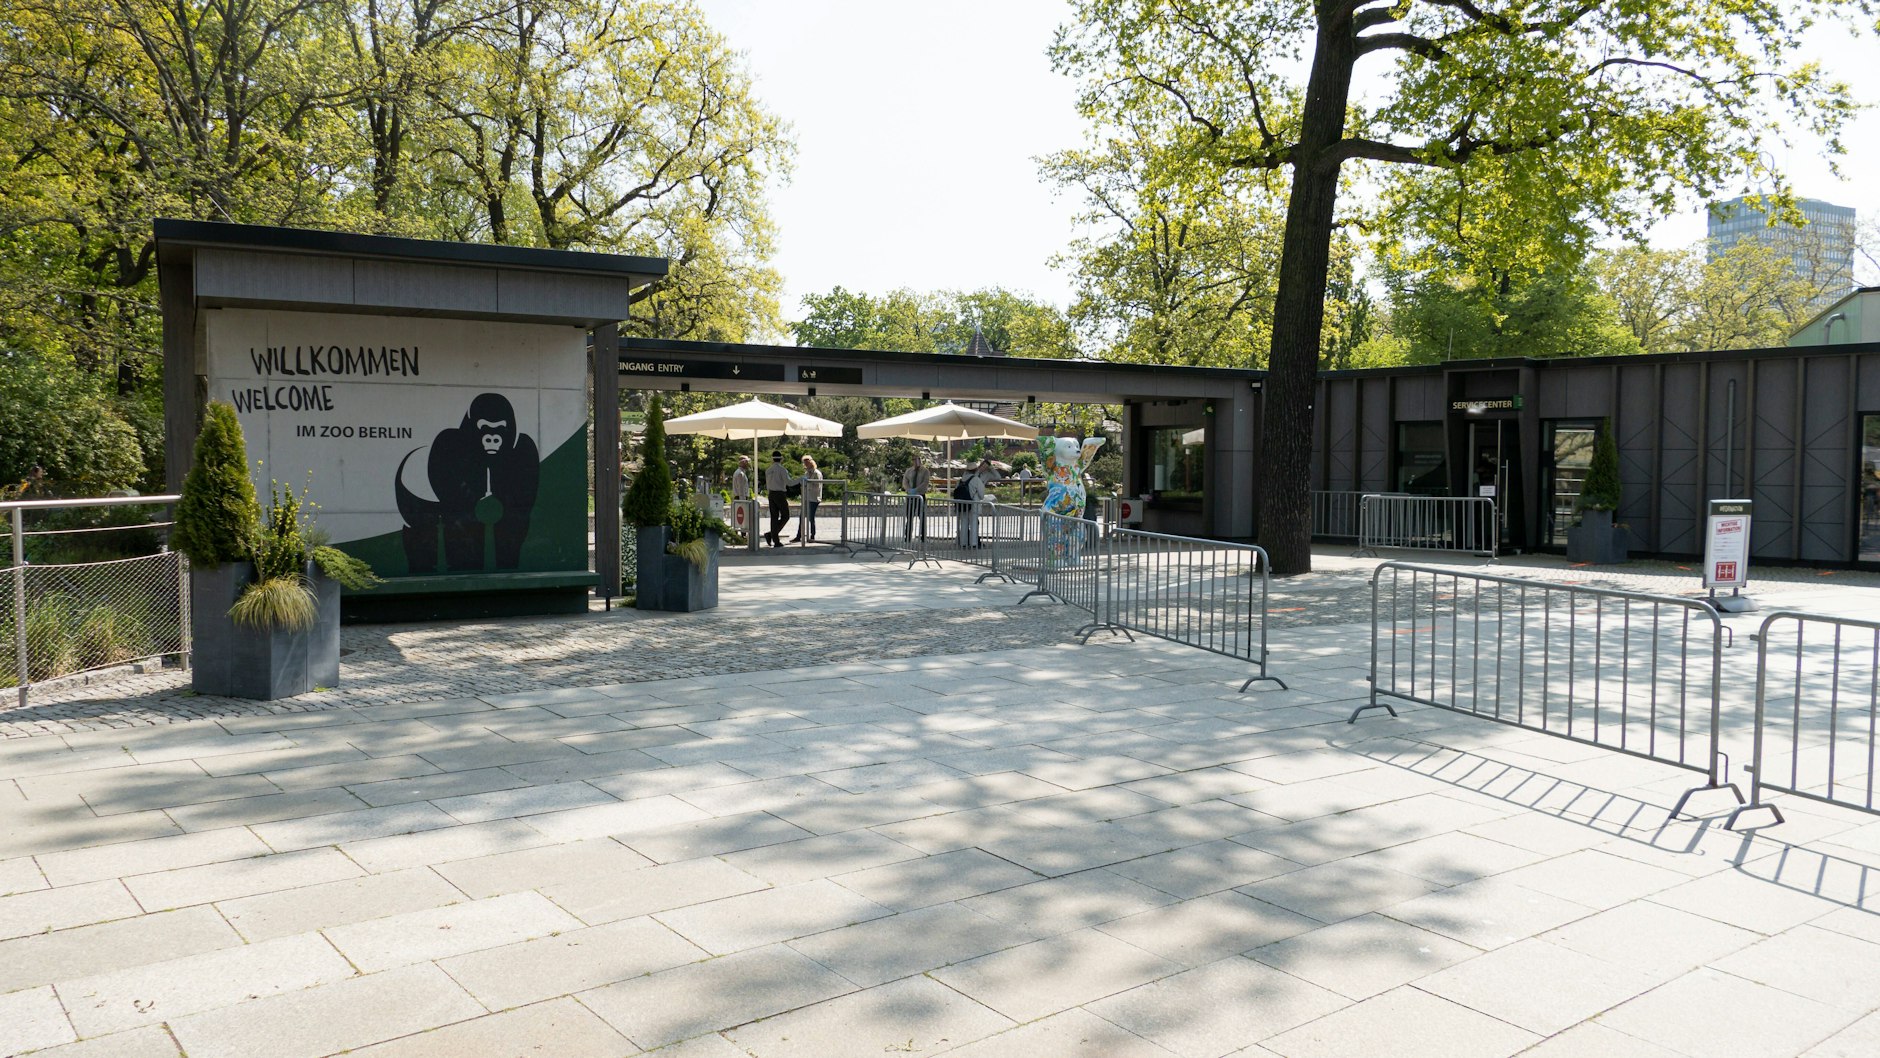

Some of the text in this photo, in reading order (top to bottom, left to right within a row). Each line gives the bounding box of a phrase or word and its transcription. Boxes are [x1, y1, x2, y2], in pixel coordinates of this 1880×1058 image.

[250, 346, 420, 377] WILLKOMMEN
[658, 363, 685, 373] ENTRY
[232, 385, 335, 414] WELCOME
[1452, 400, 1513, 410] SERVICECENTER
[296, 425, 412, 439] IM ZOO BERLIN
